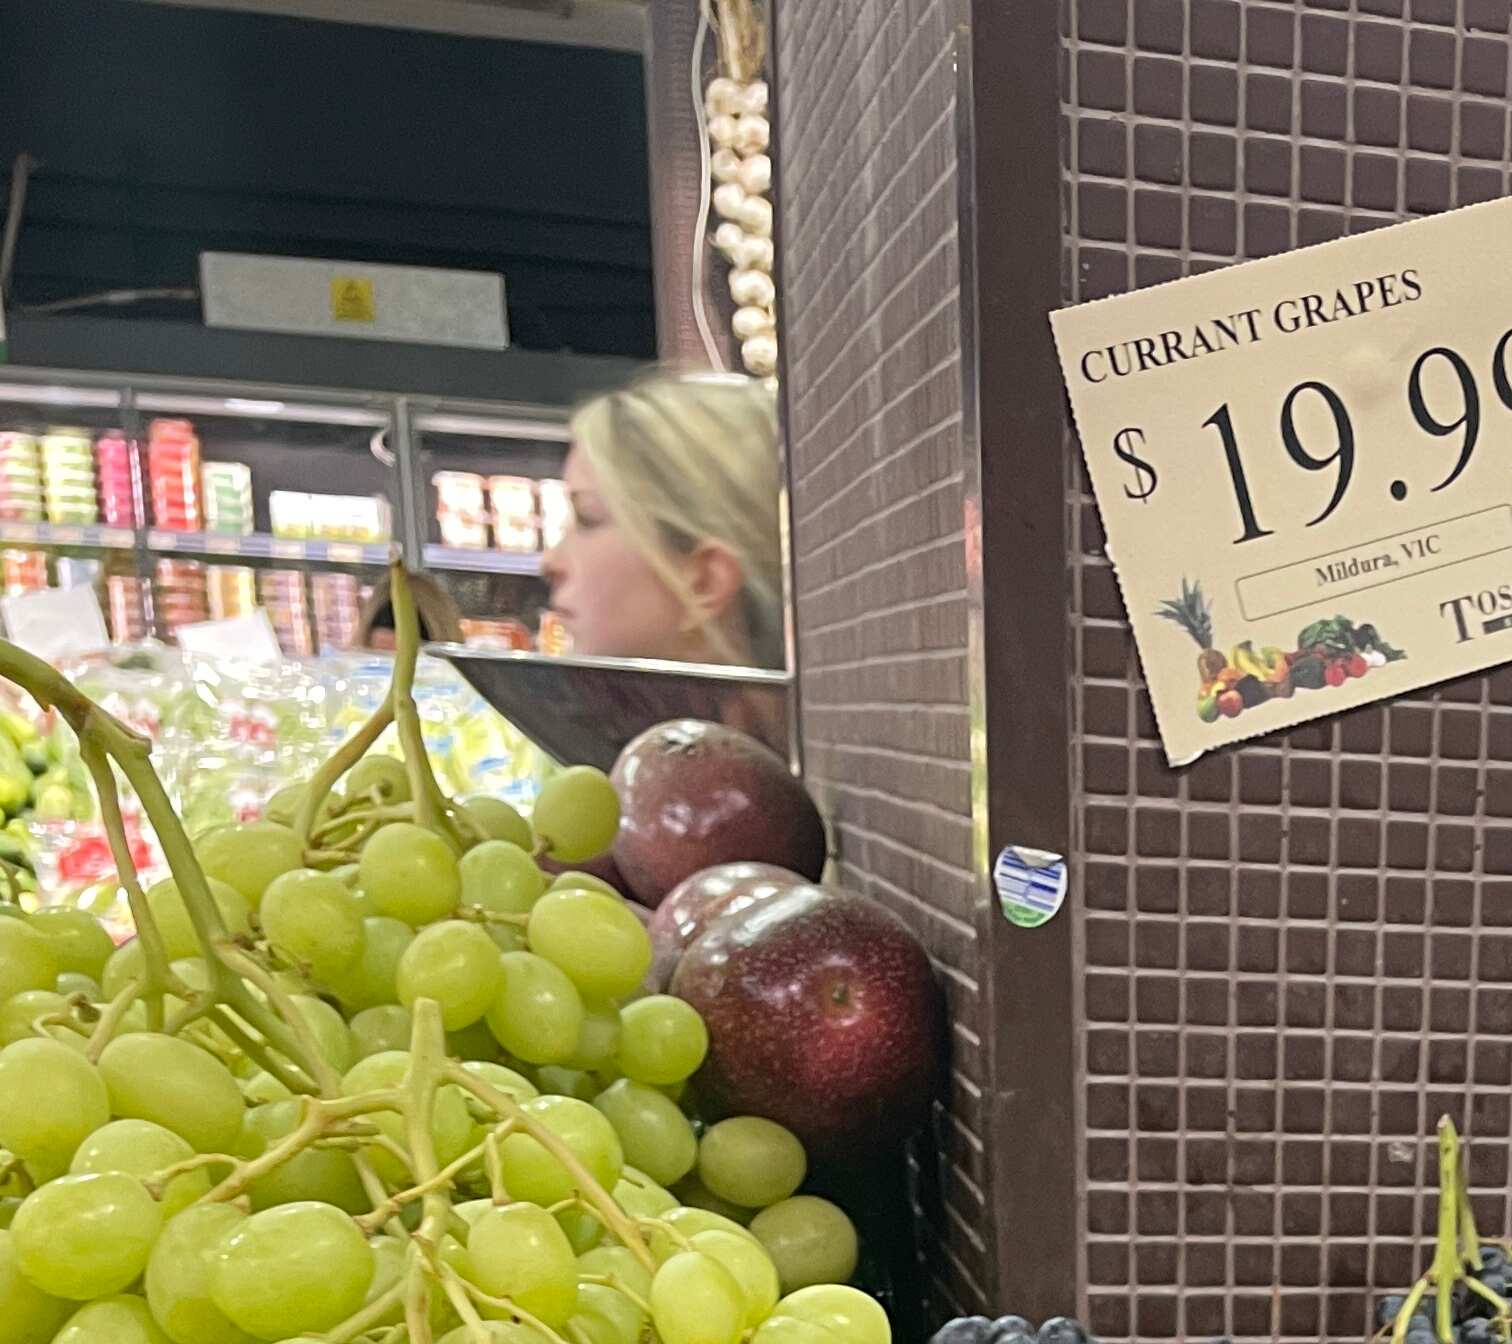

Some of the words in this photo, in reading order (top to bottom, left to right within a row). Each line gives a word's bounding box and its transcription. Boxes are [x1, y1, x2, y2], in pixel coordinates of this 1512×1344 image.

[1080, 309, 1263, 384] CURRANT
[1273, 268, 1423, 336] GRAPES
[1112, 426, 1159, 506] $
[1315, 546, 1400, 588] Mildura,
[1400, 533, 1442, 564] VIC
